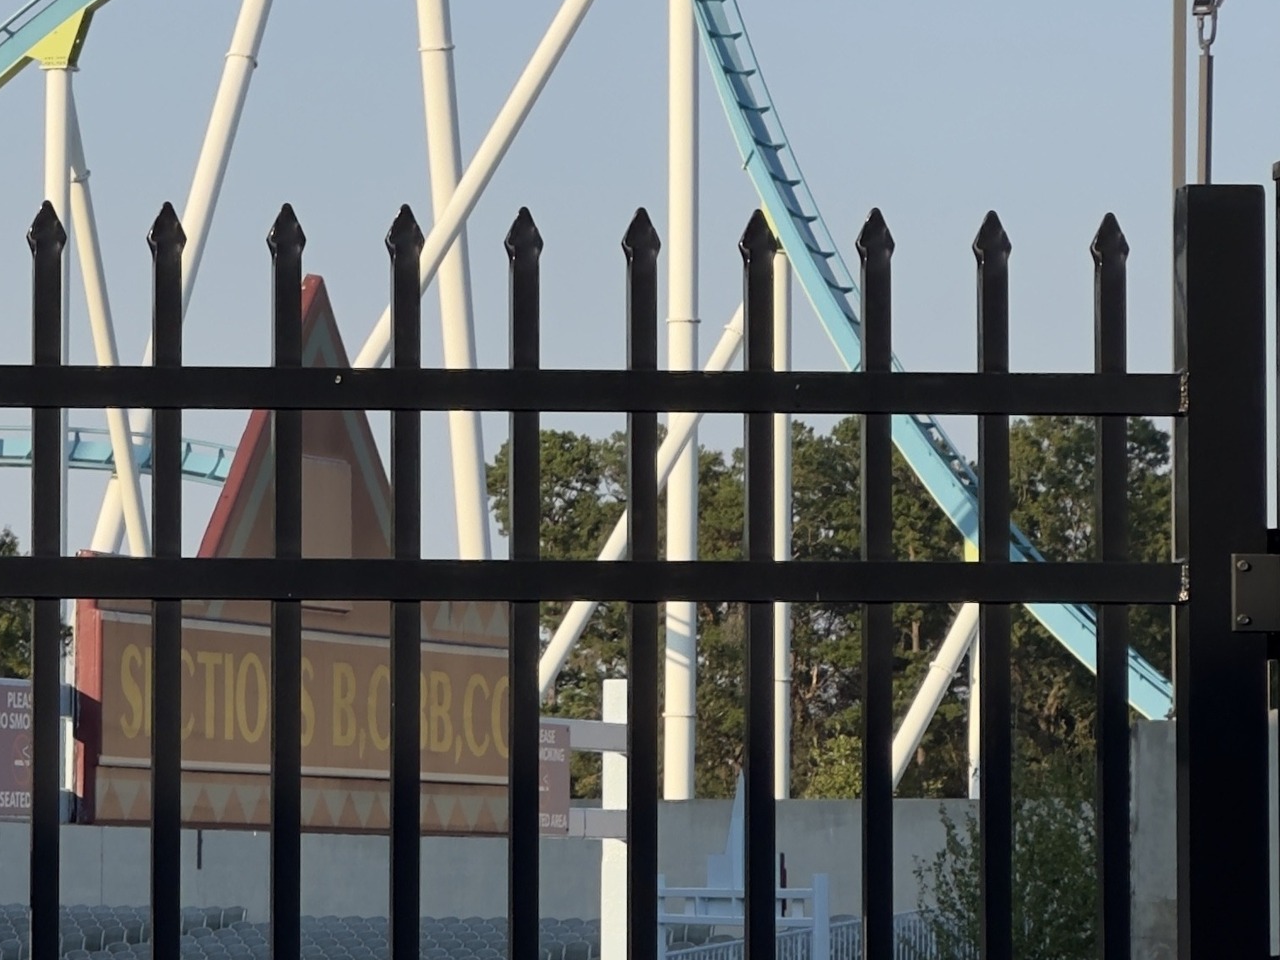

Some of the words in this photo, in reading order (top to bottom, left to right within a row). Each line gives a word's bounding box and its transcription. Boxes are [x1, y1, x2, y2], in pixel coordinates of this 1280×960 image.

[121, 643, 315, 747] SCTIOS
[0, 791, 31, 809] SEATED
[551, 813, 567, 828] AREA
